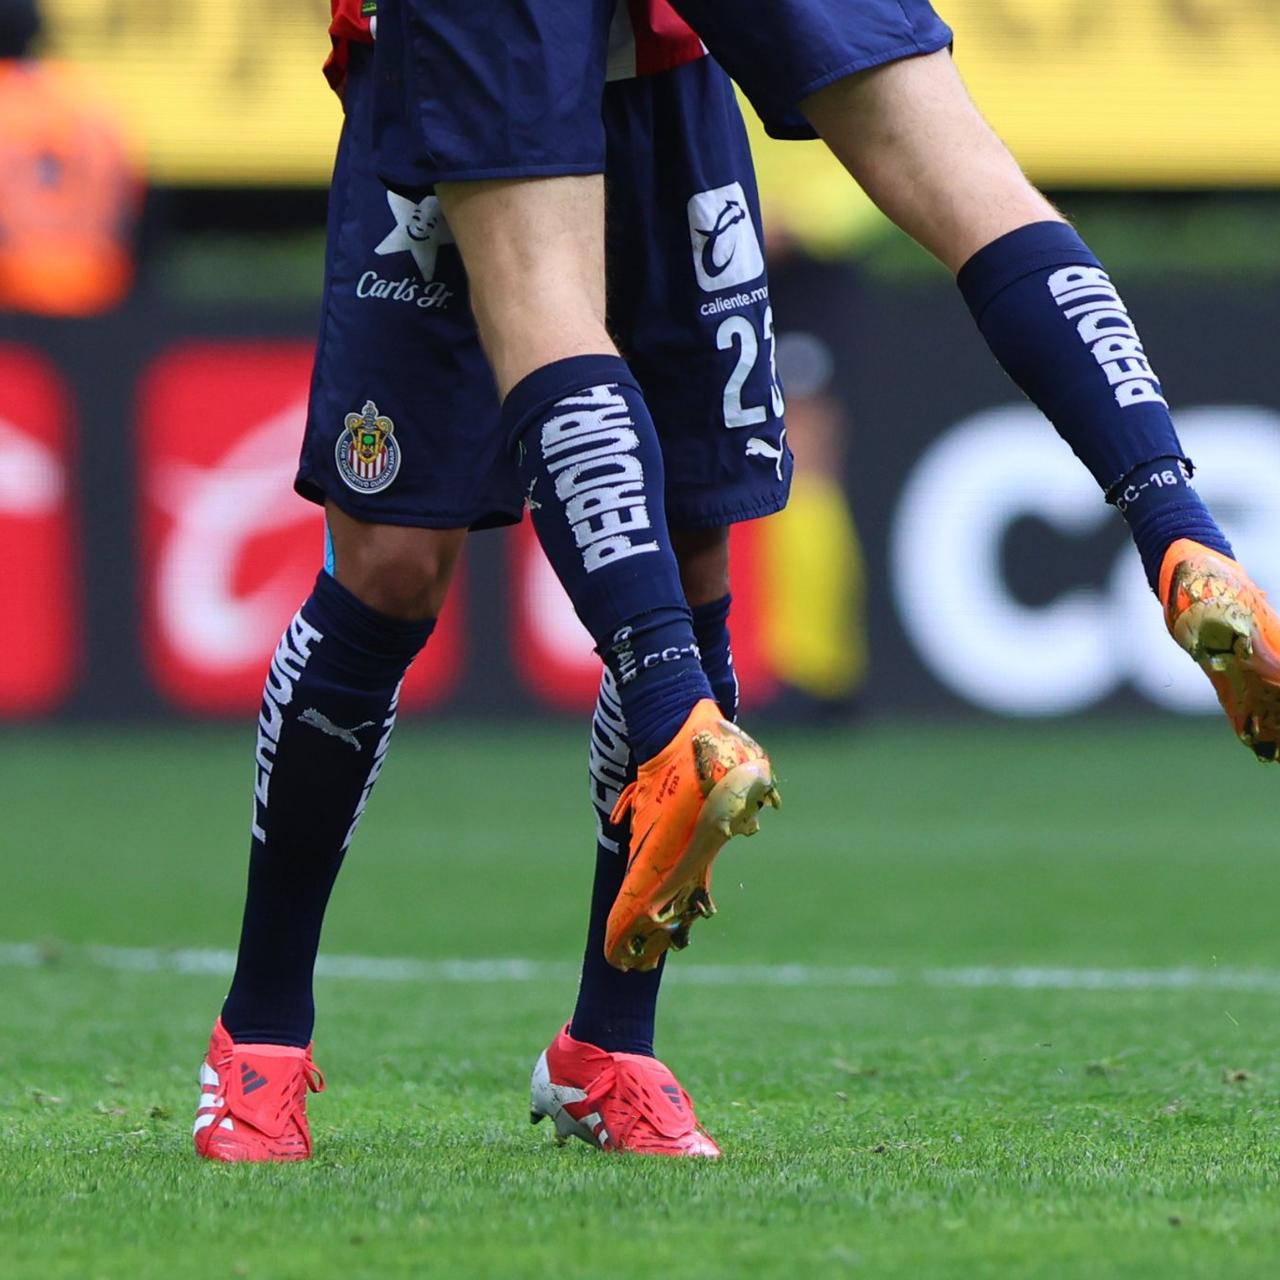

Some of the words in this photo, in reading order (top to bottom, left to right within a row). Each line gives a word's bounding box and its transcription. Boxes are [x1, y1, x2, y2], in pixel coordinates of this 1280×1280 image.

[356, 271, 419, 301] Carl's
[417, 282, 454, 309] Jr.
[643, 643, 701, 668] CC-1
